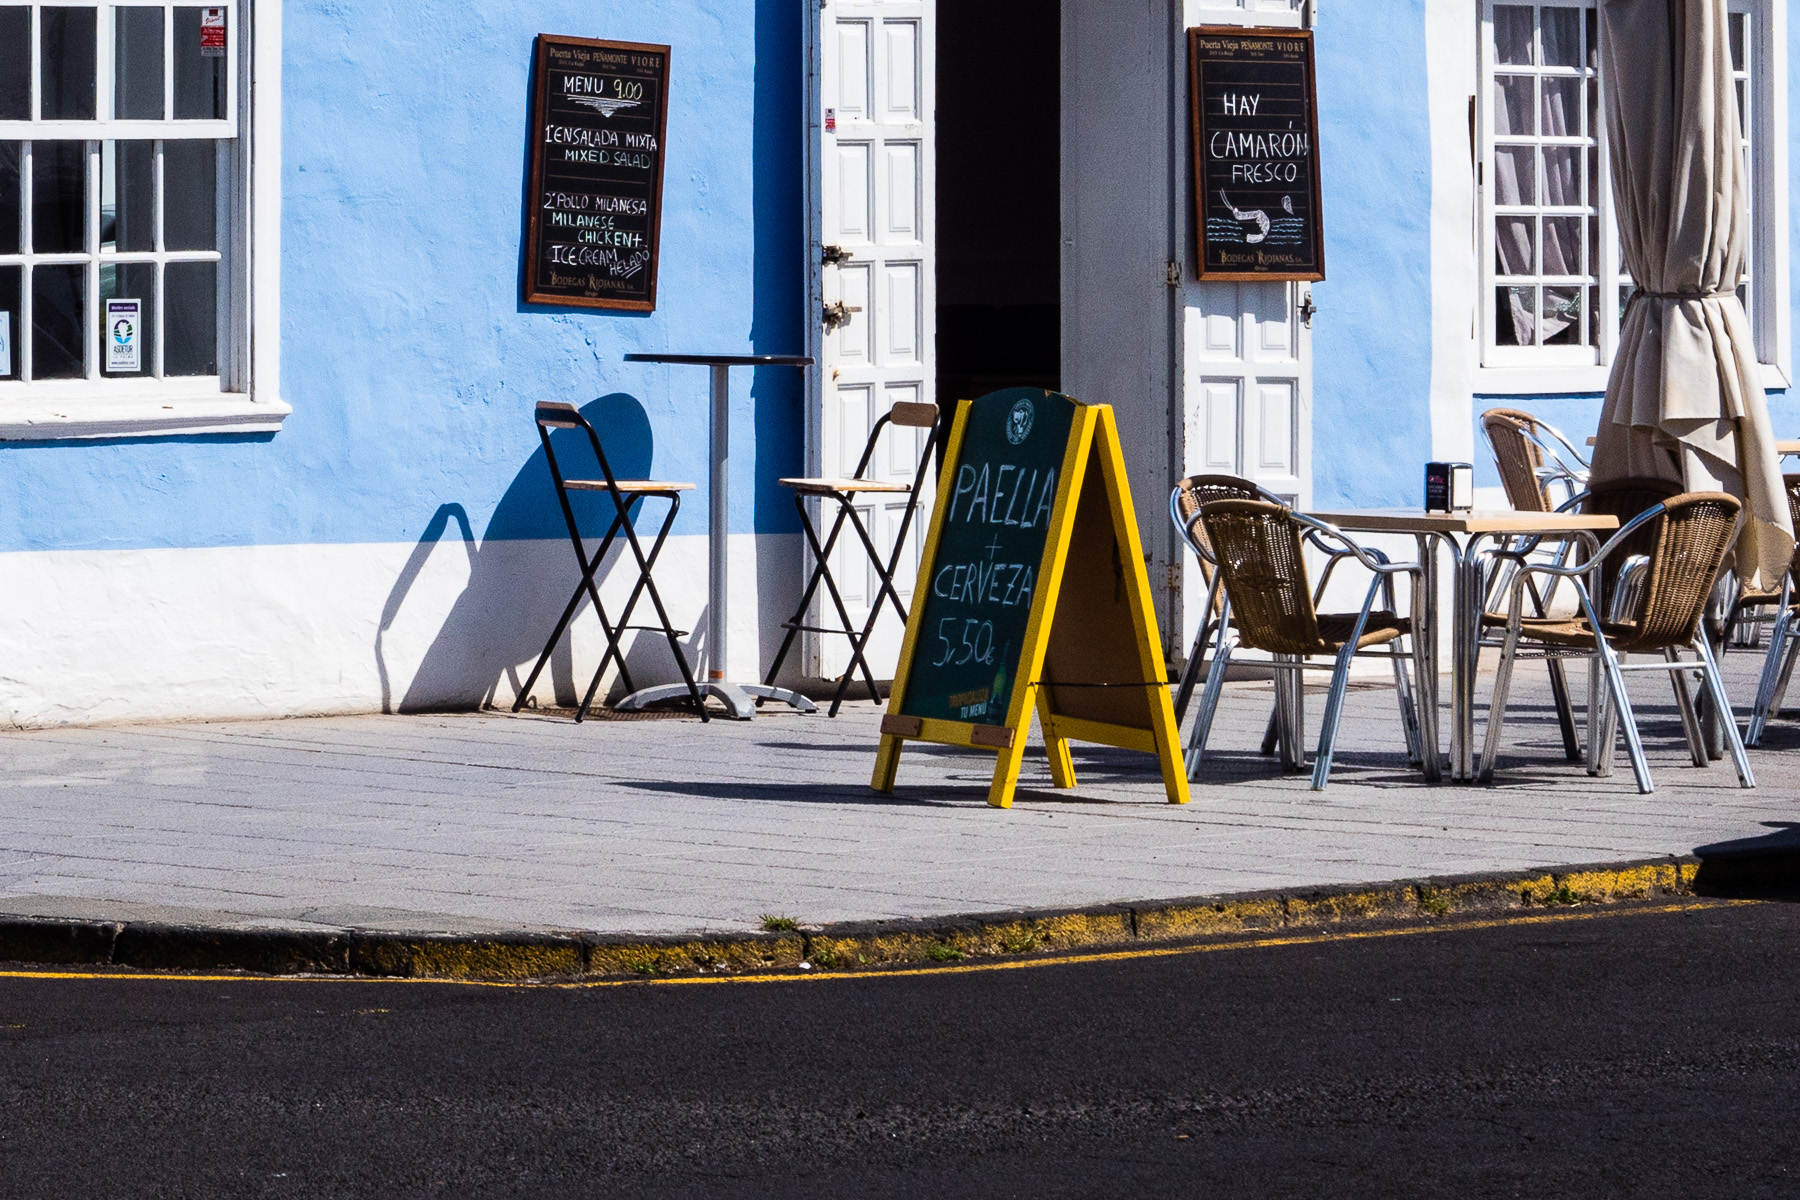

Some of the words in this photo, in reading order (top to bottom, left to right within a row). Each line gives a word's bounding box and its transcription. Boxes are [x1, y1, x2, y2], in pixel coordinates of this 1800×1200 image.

[1200, 39, 1221, 50] Puerta
[1222, 40, 1238, 51] Vieja
[1276, 42, 1304, 52] VIORE
[549, 47, 571, 59] Puerta
[573, 49, 590, 62] Vieja
[631, 55, 660, 68] VIORE
[563, 75, 604, 94] MENU
[613, 78, 643, 100] 9.00
[1223, 93, 1260, 116] HAY
[625, 133, 657, 152] MIXTA
[1210, 120, 1308, 158] CAMARÓN
[564, 149, 610, 164] MIXED
[613, 151, 651, 169] SALAD
[1232, 162, 1297, 184] FRESCO
[595, 196, 647, 215] MILANESA
[552, 211, 615, 230] MILANESE
[551, 245, 578, 266] ICE
[579, 246, 618, 267] CREAM
[609, 250, 650, 276] HELADO
[1220, 249, 1254, 265] BODEGAS
[551, 271, 586, 287] BODEGAS
[949, 462, 1055, 530] PAELLA
[934, 560, 1033, 610] CERVEZA
